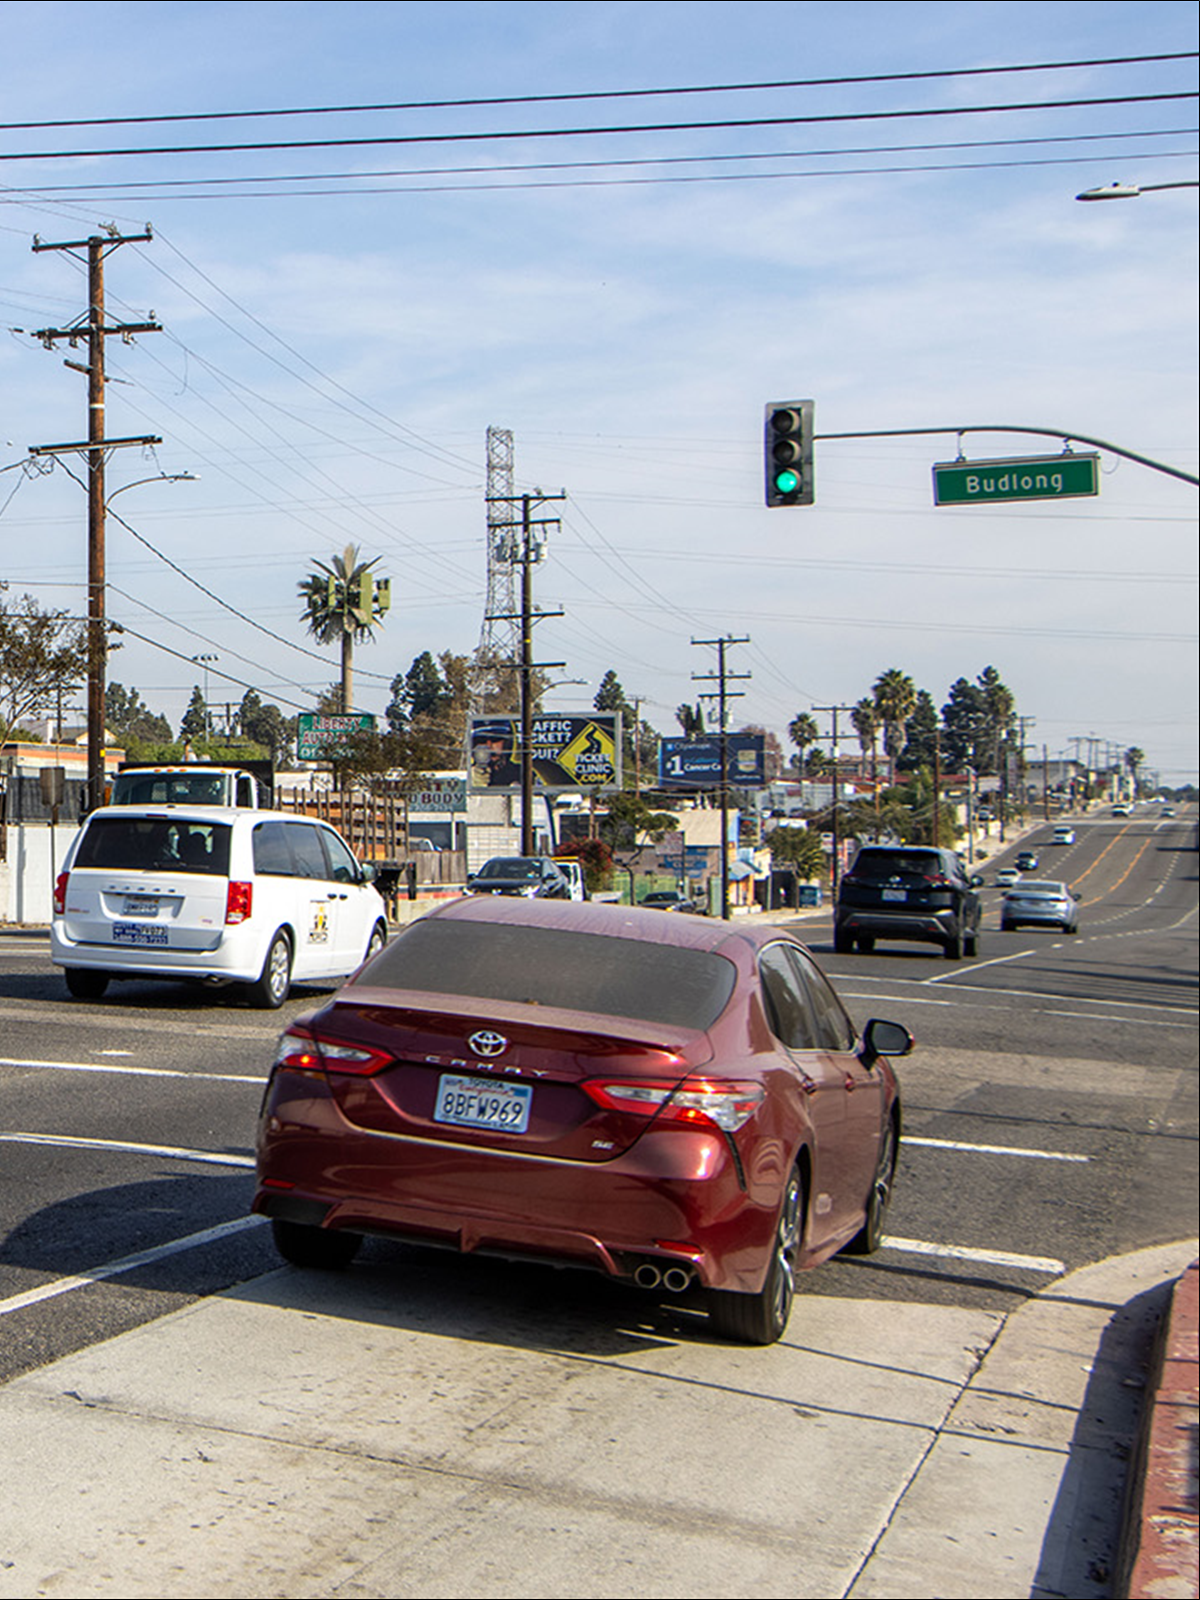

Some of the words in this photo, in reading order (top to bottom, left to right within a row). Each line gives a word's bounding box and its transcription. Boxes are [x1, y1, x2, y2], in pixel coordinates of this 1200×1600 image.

[966, 473, 1062, 494] Budlong
[313, 716, 361, 730] LIBERTY
[515, 720, 572, 732] TAFFIC
[515, 732, 572, 744] TCKET?
[574, 753, 611, 763] TICKET
[574, 763, 612, 774] CLINIC
[684, 763, 711, 772] Cancer
[421, 793, 464, 804] BODY
[425, 1055, 549, 1077] CAMRY
[469, 1077, 504, 1090] TOYOTA
[443, 1092, 523, 1123] 8BFW969
